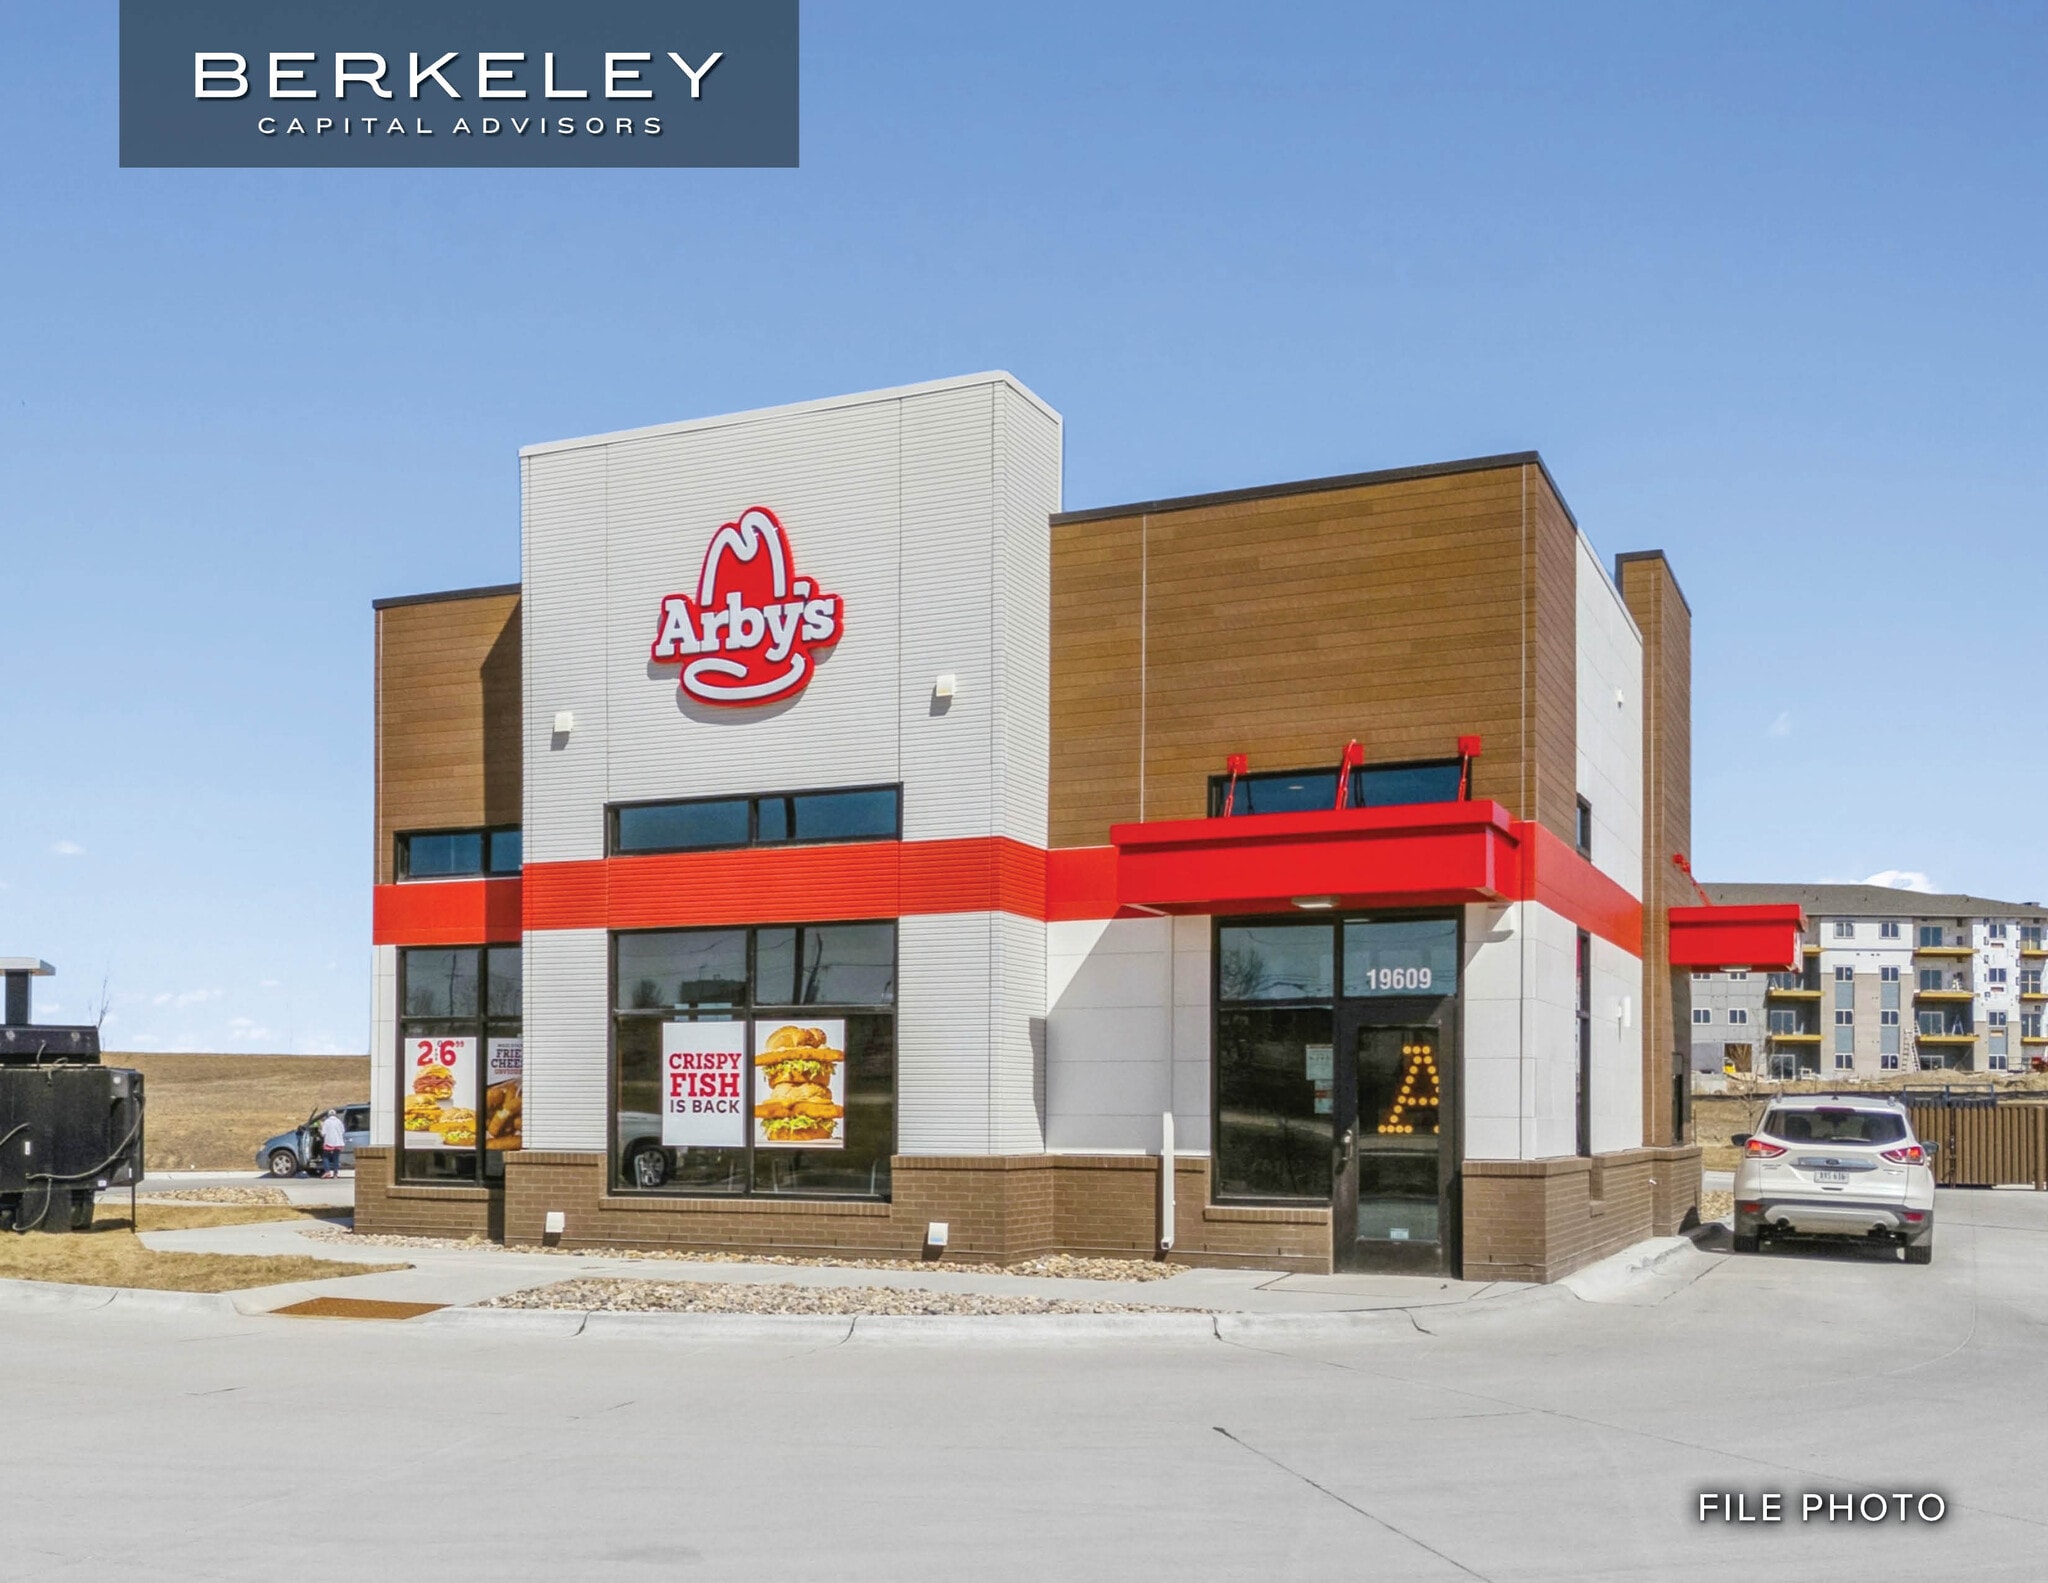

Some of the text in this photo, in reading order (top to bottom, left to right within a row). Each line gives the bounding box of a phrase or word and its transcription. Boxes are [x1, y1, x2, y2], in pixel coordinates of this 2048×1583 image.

[655, 580, 835, 662] Arby's
[1366, 967, 1432, 990] 19609
[496, 1048, 523, 1058] FRIE
[669, 1053, 742, 1070] CRISPY
[670, 1073, 740, 1098] FISH
[670, 1100, 740, 1114] IS BACK
